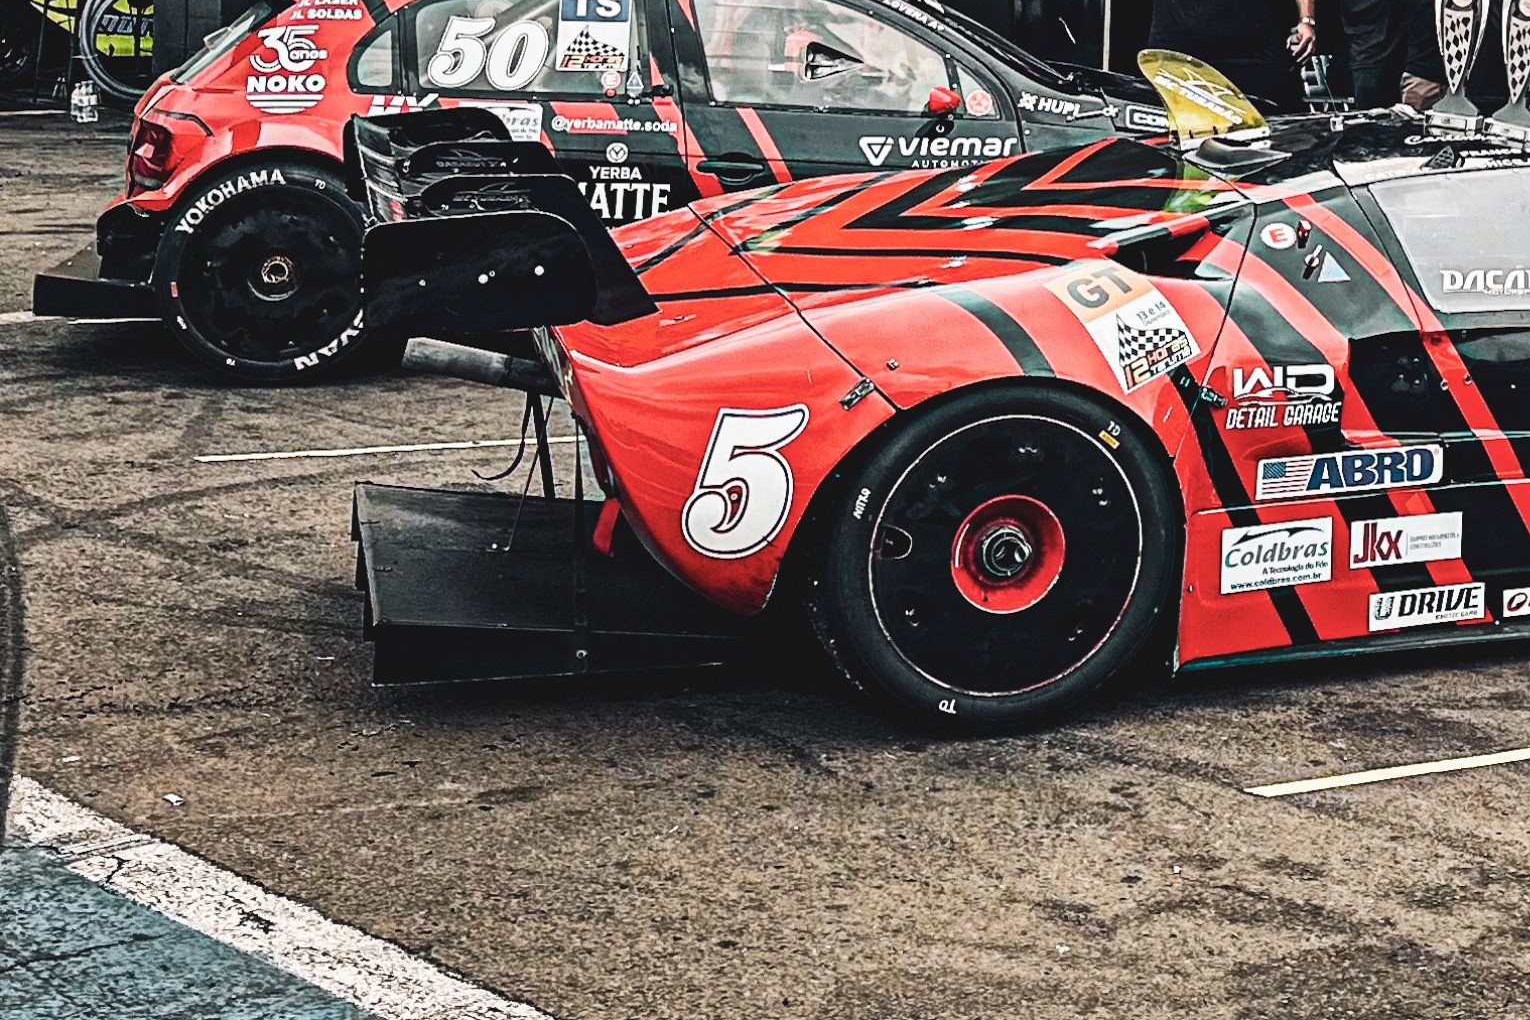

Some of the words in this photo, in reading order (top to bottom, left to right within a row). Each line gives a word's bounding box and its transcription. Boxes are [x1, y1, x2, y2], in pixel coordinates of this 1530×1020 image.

[290, 9, 304, 20] JL
[307, 8, 363, 20] SOLDAS
[250, 24, 320, 72] 35
[289, 49, 328, 60] anos
[427, 16, 549, 91] 50
[246, 74, 326, 93] NOKO
[551, 116, 678, 132] @yerbamatte.soda
[898, 136, 1018, 157] viemar
[589, 165, 643, 180] YERBA
[175, 168, 287, 234] YOKOHAMA
[578, 183, 671, 220] ATTE
[1268, 227, 1288, 244] E
[1066, 267, 1133, 308] GT
[1136, 311, 1148, 322] 13
[1154, 300, 1166, 311] 14
[1124, 356, 1151, 391] 12
[1225, 405, 1279, 430] DETAIL
[1283, 401, 1342, 427] GARAGE
[682, 404, 810, 559] 5
[1306, 448, 1435, 491] ABRO
[852, 487, 872, 520] NITRO
[1225, 542, 1329, 569] Coldbras
[1398, 585, 1482, 618] DRIVE
